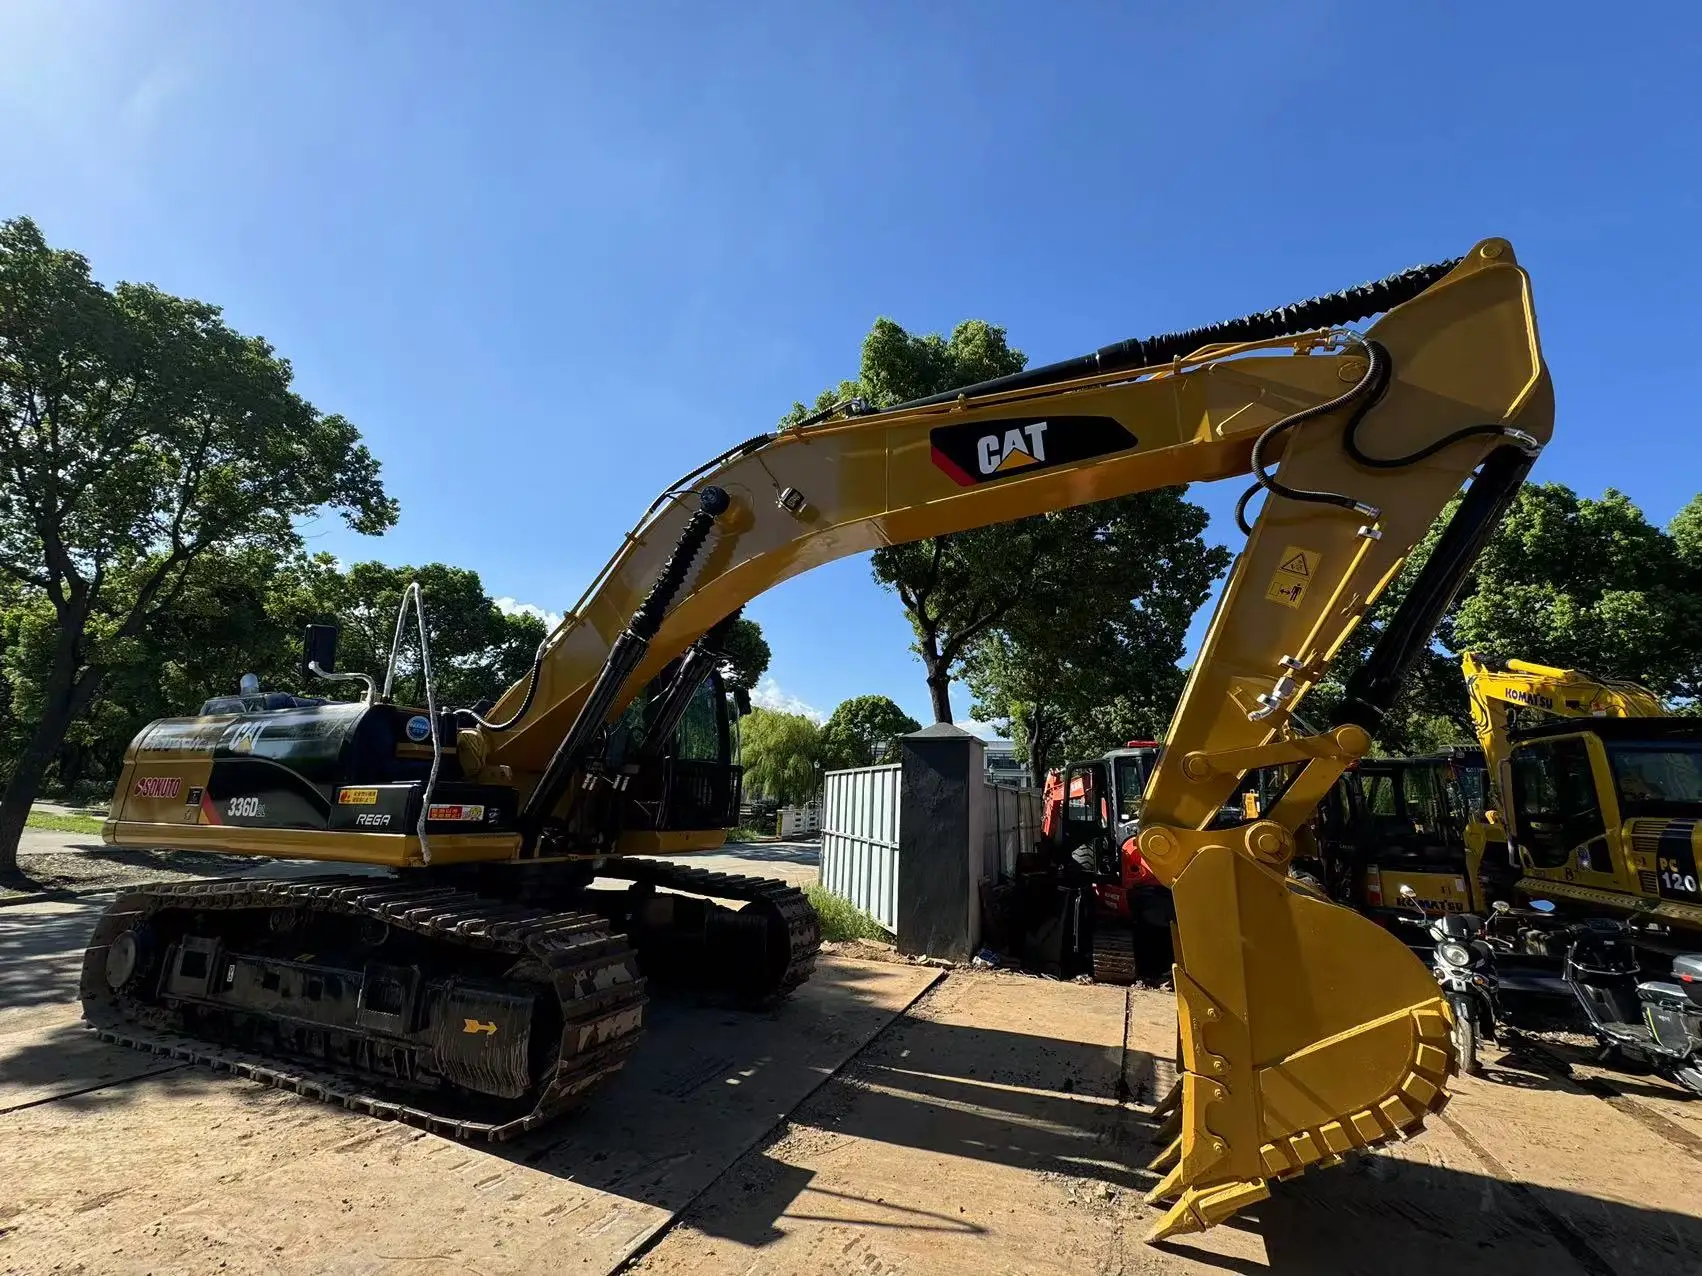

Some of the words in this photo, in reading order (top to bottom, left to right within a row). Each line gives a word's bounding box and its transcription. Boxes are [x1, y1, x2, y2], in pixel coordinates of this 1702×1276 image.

[977, 422, 1048, 475] CAT
[1505, 688, 1553, 710] KOMATSU
[229, 720, 273, 751] CAT
[355, 813, 392, 826] REGA
[1659, 857, 1679, 873] PC
[1661, 871, 1697, 892] 120
